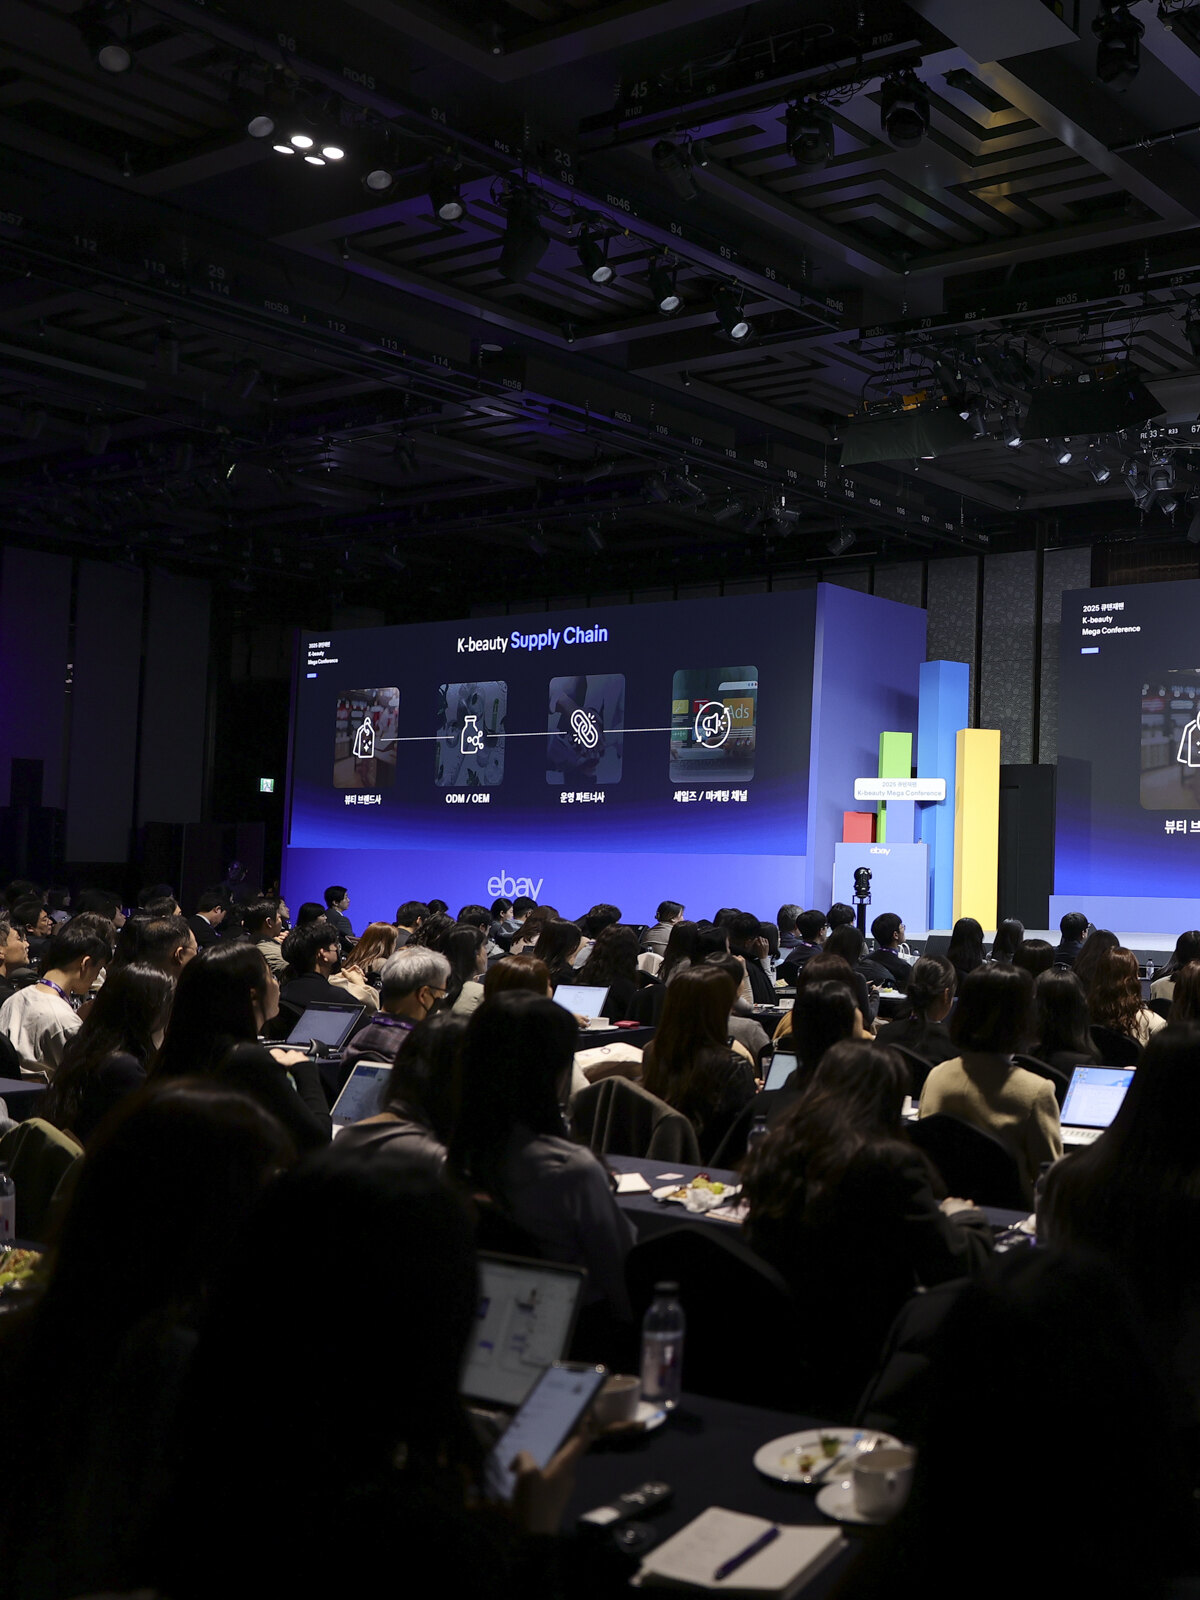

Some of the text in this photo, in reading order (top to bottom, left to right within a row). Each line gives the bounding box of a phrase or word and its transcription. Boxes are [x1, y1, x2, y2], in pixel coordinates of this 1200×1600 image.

[278, 33, 297, 52] 96
[872, 32, 894, 46] R102
[630, 80, 648, 98] 45
[431, 107, 447, 124] 94
[554, 148, 571, 167] 23
[560, 170, 575, 186] 96
[606, 194, 631, 212] RD46
[670, 222, 683, 236] 94
[73, 235, 97, 251] 112
[719, 245, 731, 260] 95
[143, 258, 166, 275] 113
[208, 264, 226, 280] 29
[765, 267, 776, 280] 96
[1113, 269, 1126, 281] 18
[209, 280, 230, 296] 114
[1118, 284, 1130, 294] 70
[826, 297, 844, 312] RD46
[1056, 293, 1078, 305] RD35
[264, 300, 290, 315] RD58
[1016, 302, 1028, 312] 72
[965, 312, 976, 320] R35
[328, 320, 347, 334] 112
[921, 318, 932, 328] 70
[381, 337, 398, 350] 113
[432, 355, 449, 367] 114
[502, 379, 522, 391] RD58
[656, 425, 668, 435] 106
[1191, 424, 1200, 433] 67
[691, 436, 703, 447] 107
[725, 449, 737, 459] 108
[787, 469, 798, 479] 106
[817, 479, 827, 489] 107
[1082, 616, 1113, 624] K-beauty
[1082, 625, 1141, 636] Mega Conference
[457, 624, 608, 653] K-beauty Supply Chain
[729, 704, 750, 719] Ads
[344, 794, 382, 805] 뷰티 브랜드사
[445, 793, 465, 804] ODM
[471, 793, 490, 804] OEM
[560, 791, 605, 803] 운영 파트너사
[673, 790, 697, 802] 세일즈
[705, 790, 729, 802] 마케팅
[730, 789, 748, 802] 채널
[1164, 819, 1187, 834] 뷰티
[870, 846, 891, 856] ebay
[487, 869, 544, 901] ebay
